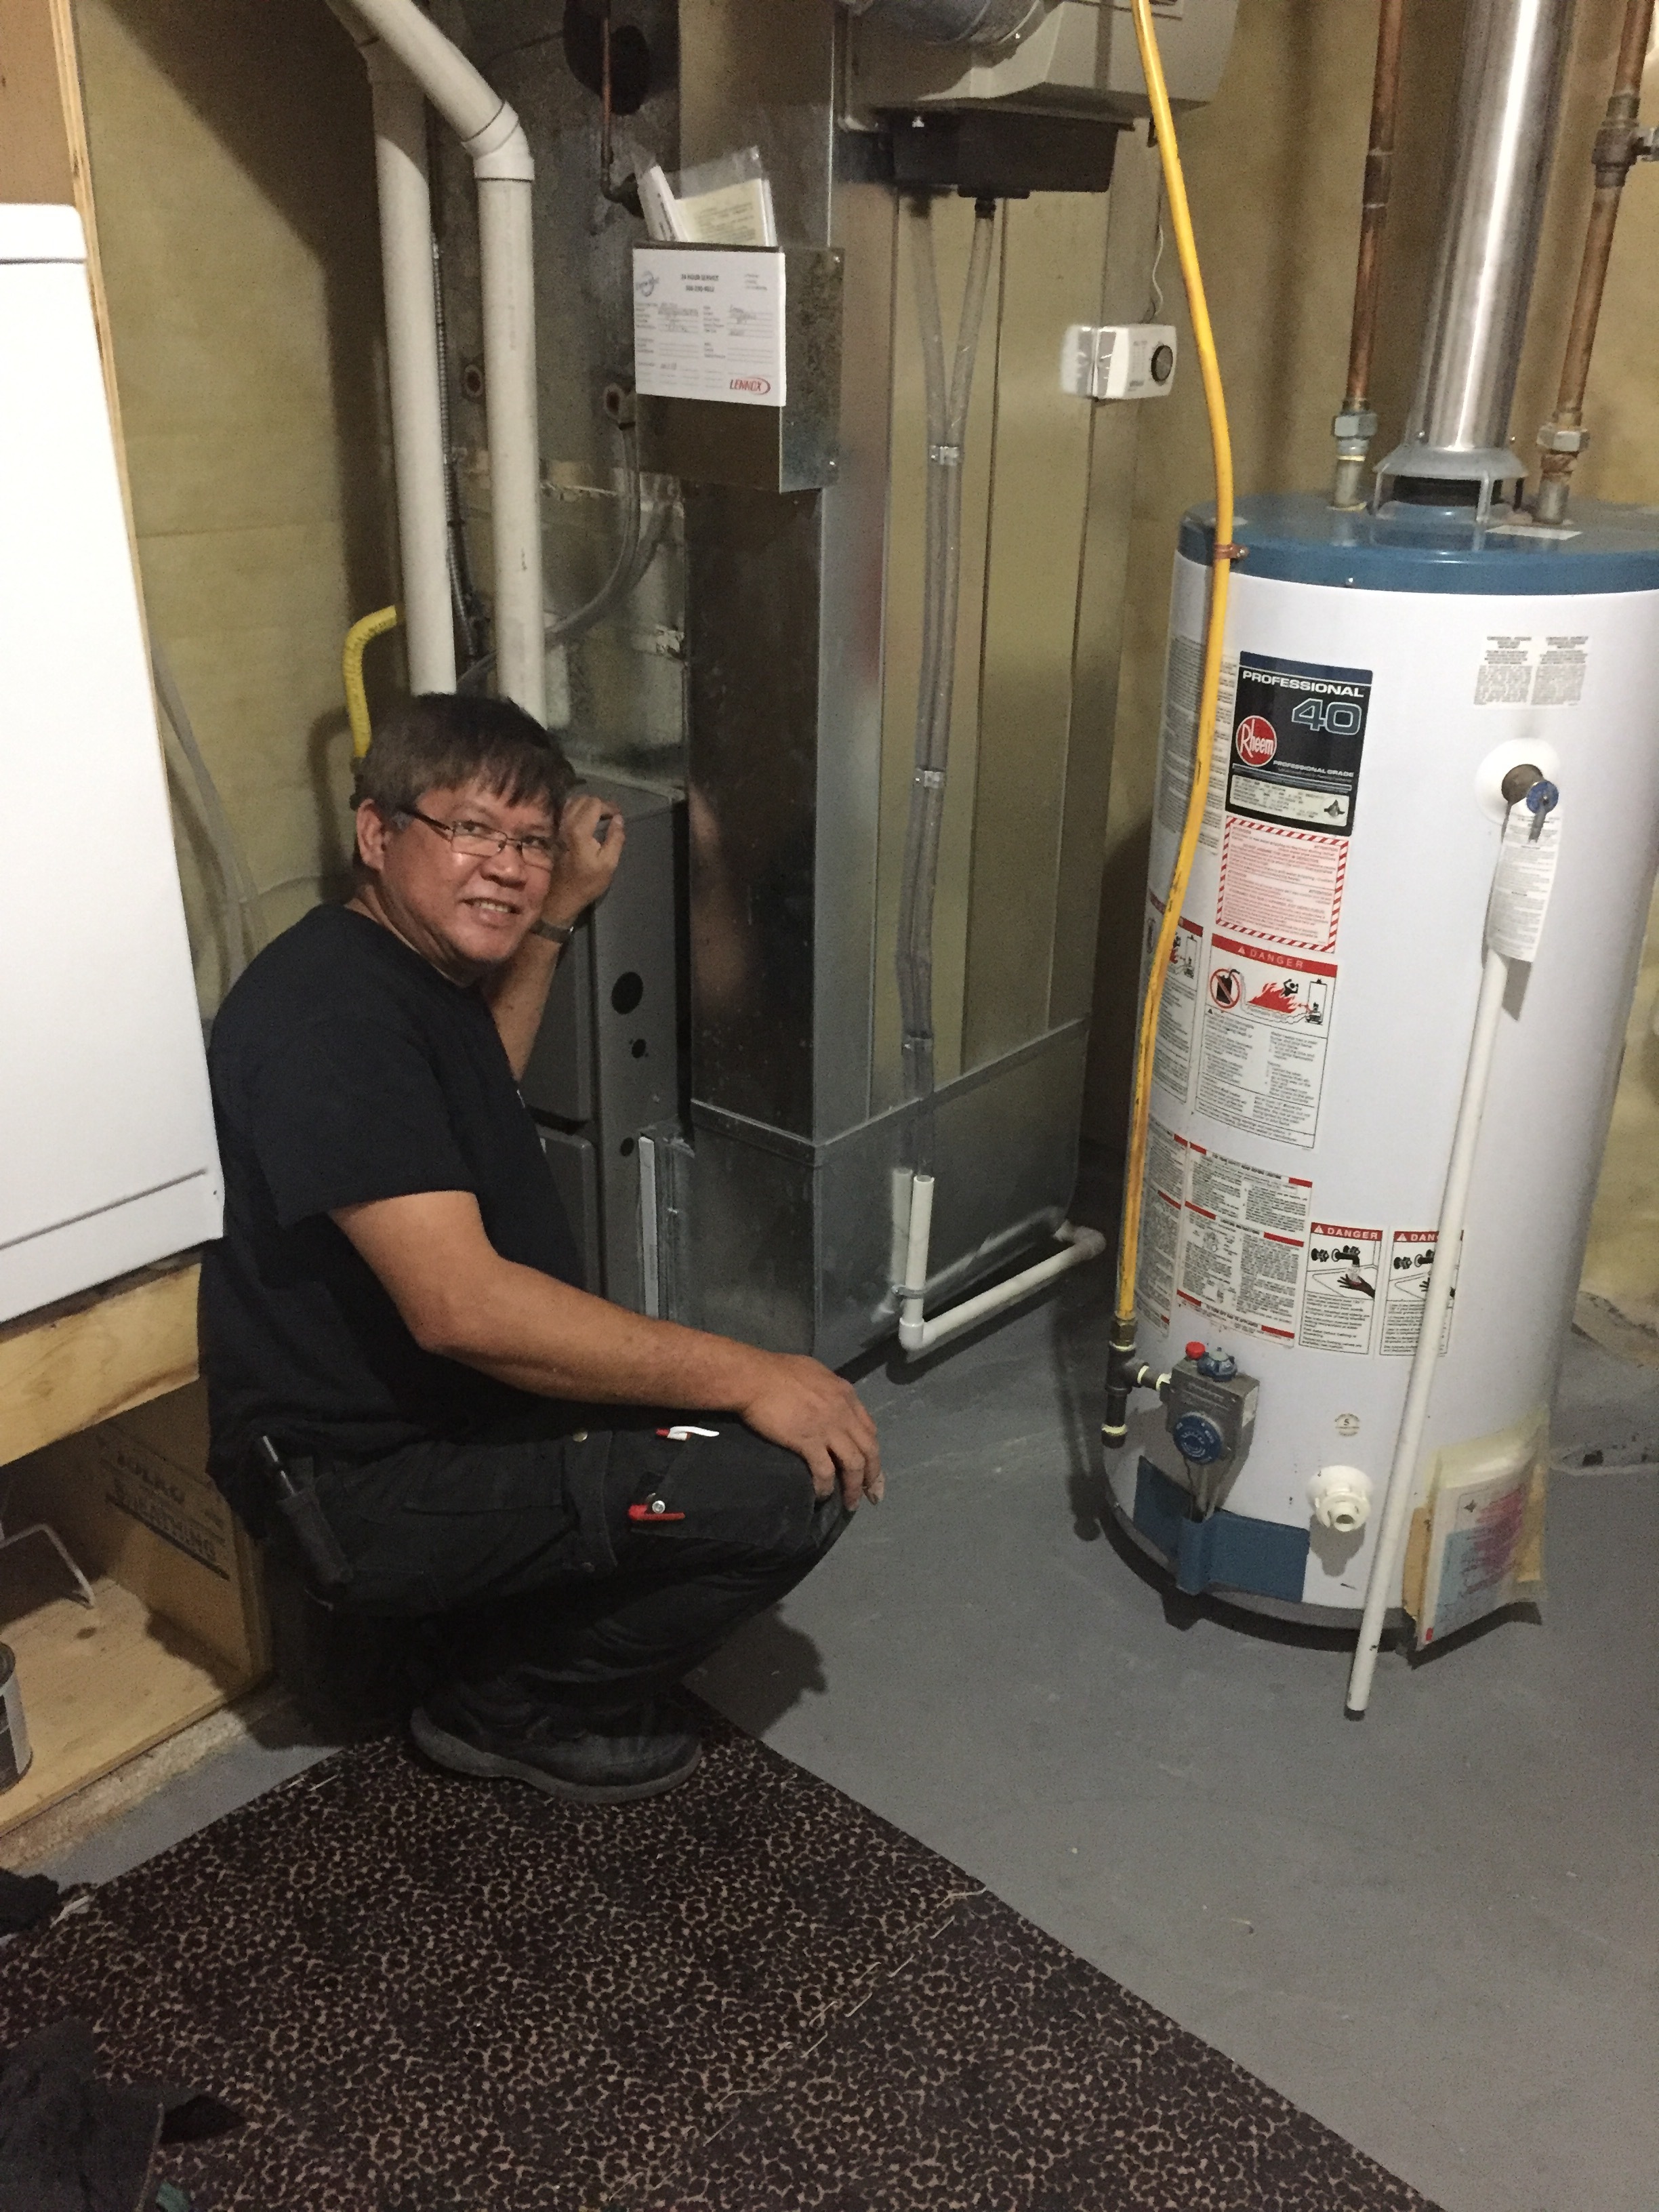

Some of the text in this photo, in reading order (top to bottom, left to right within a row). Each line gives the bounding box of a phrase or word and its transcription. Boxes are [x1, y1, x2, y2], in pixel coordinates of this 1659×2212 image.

[729, 379, 761, 391] LENNOX
[1242, 670, 1364, 697] PROFESSIONAL
[1291, 697, 1362, 735] 40
[1240, 718, 1274, 758] Rheem
[1273, 760, 1326, 774] PROFESSIONAL
[1327, 769, 1355, 777] GRADE
[1250, 947, 1304, 969] DANGER
[1327, 1227, 1378, 1240] DANGER
[1410, 1233, 1439, 1242] DAN
